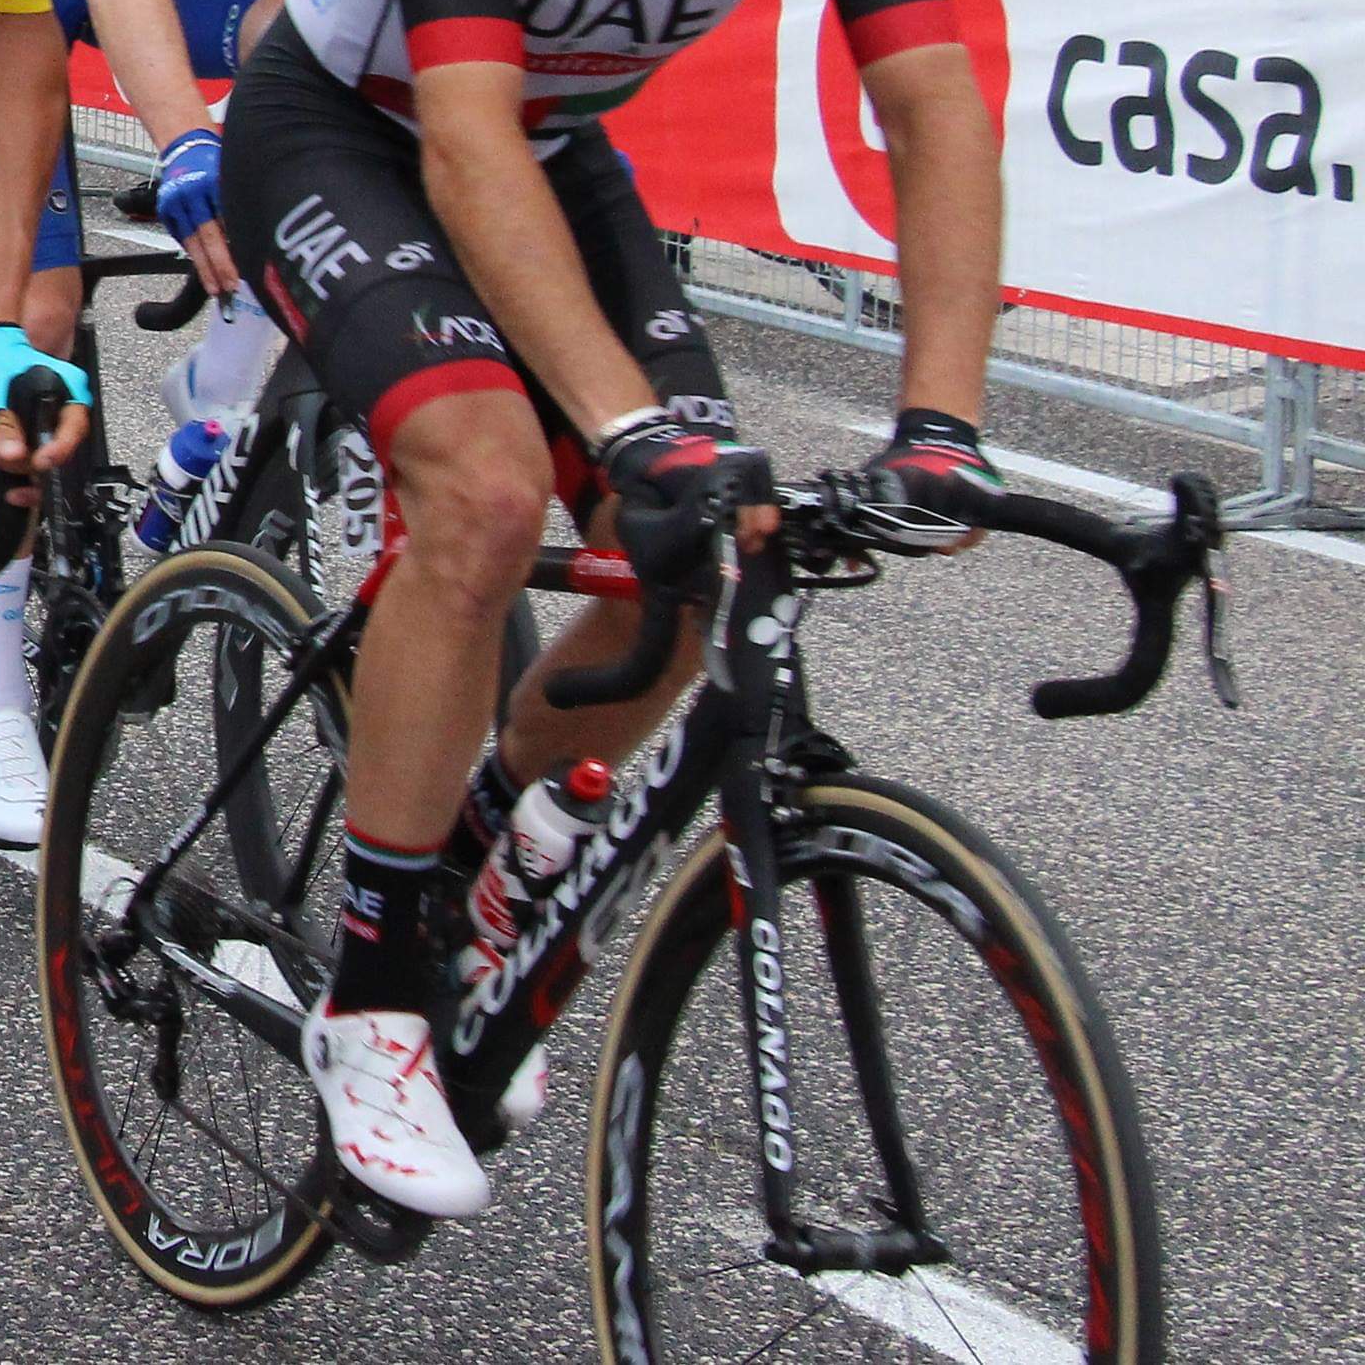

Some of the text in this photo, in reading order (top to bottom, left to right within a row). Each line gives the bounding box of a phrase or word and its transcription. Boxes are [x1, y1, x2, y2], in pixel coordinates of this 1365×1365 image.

[1046, 32, 1354, 202] casa.
[273, 193, 372, 301] UAE
[751, 917, 794, 1173] COLNAGO
